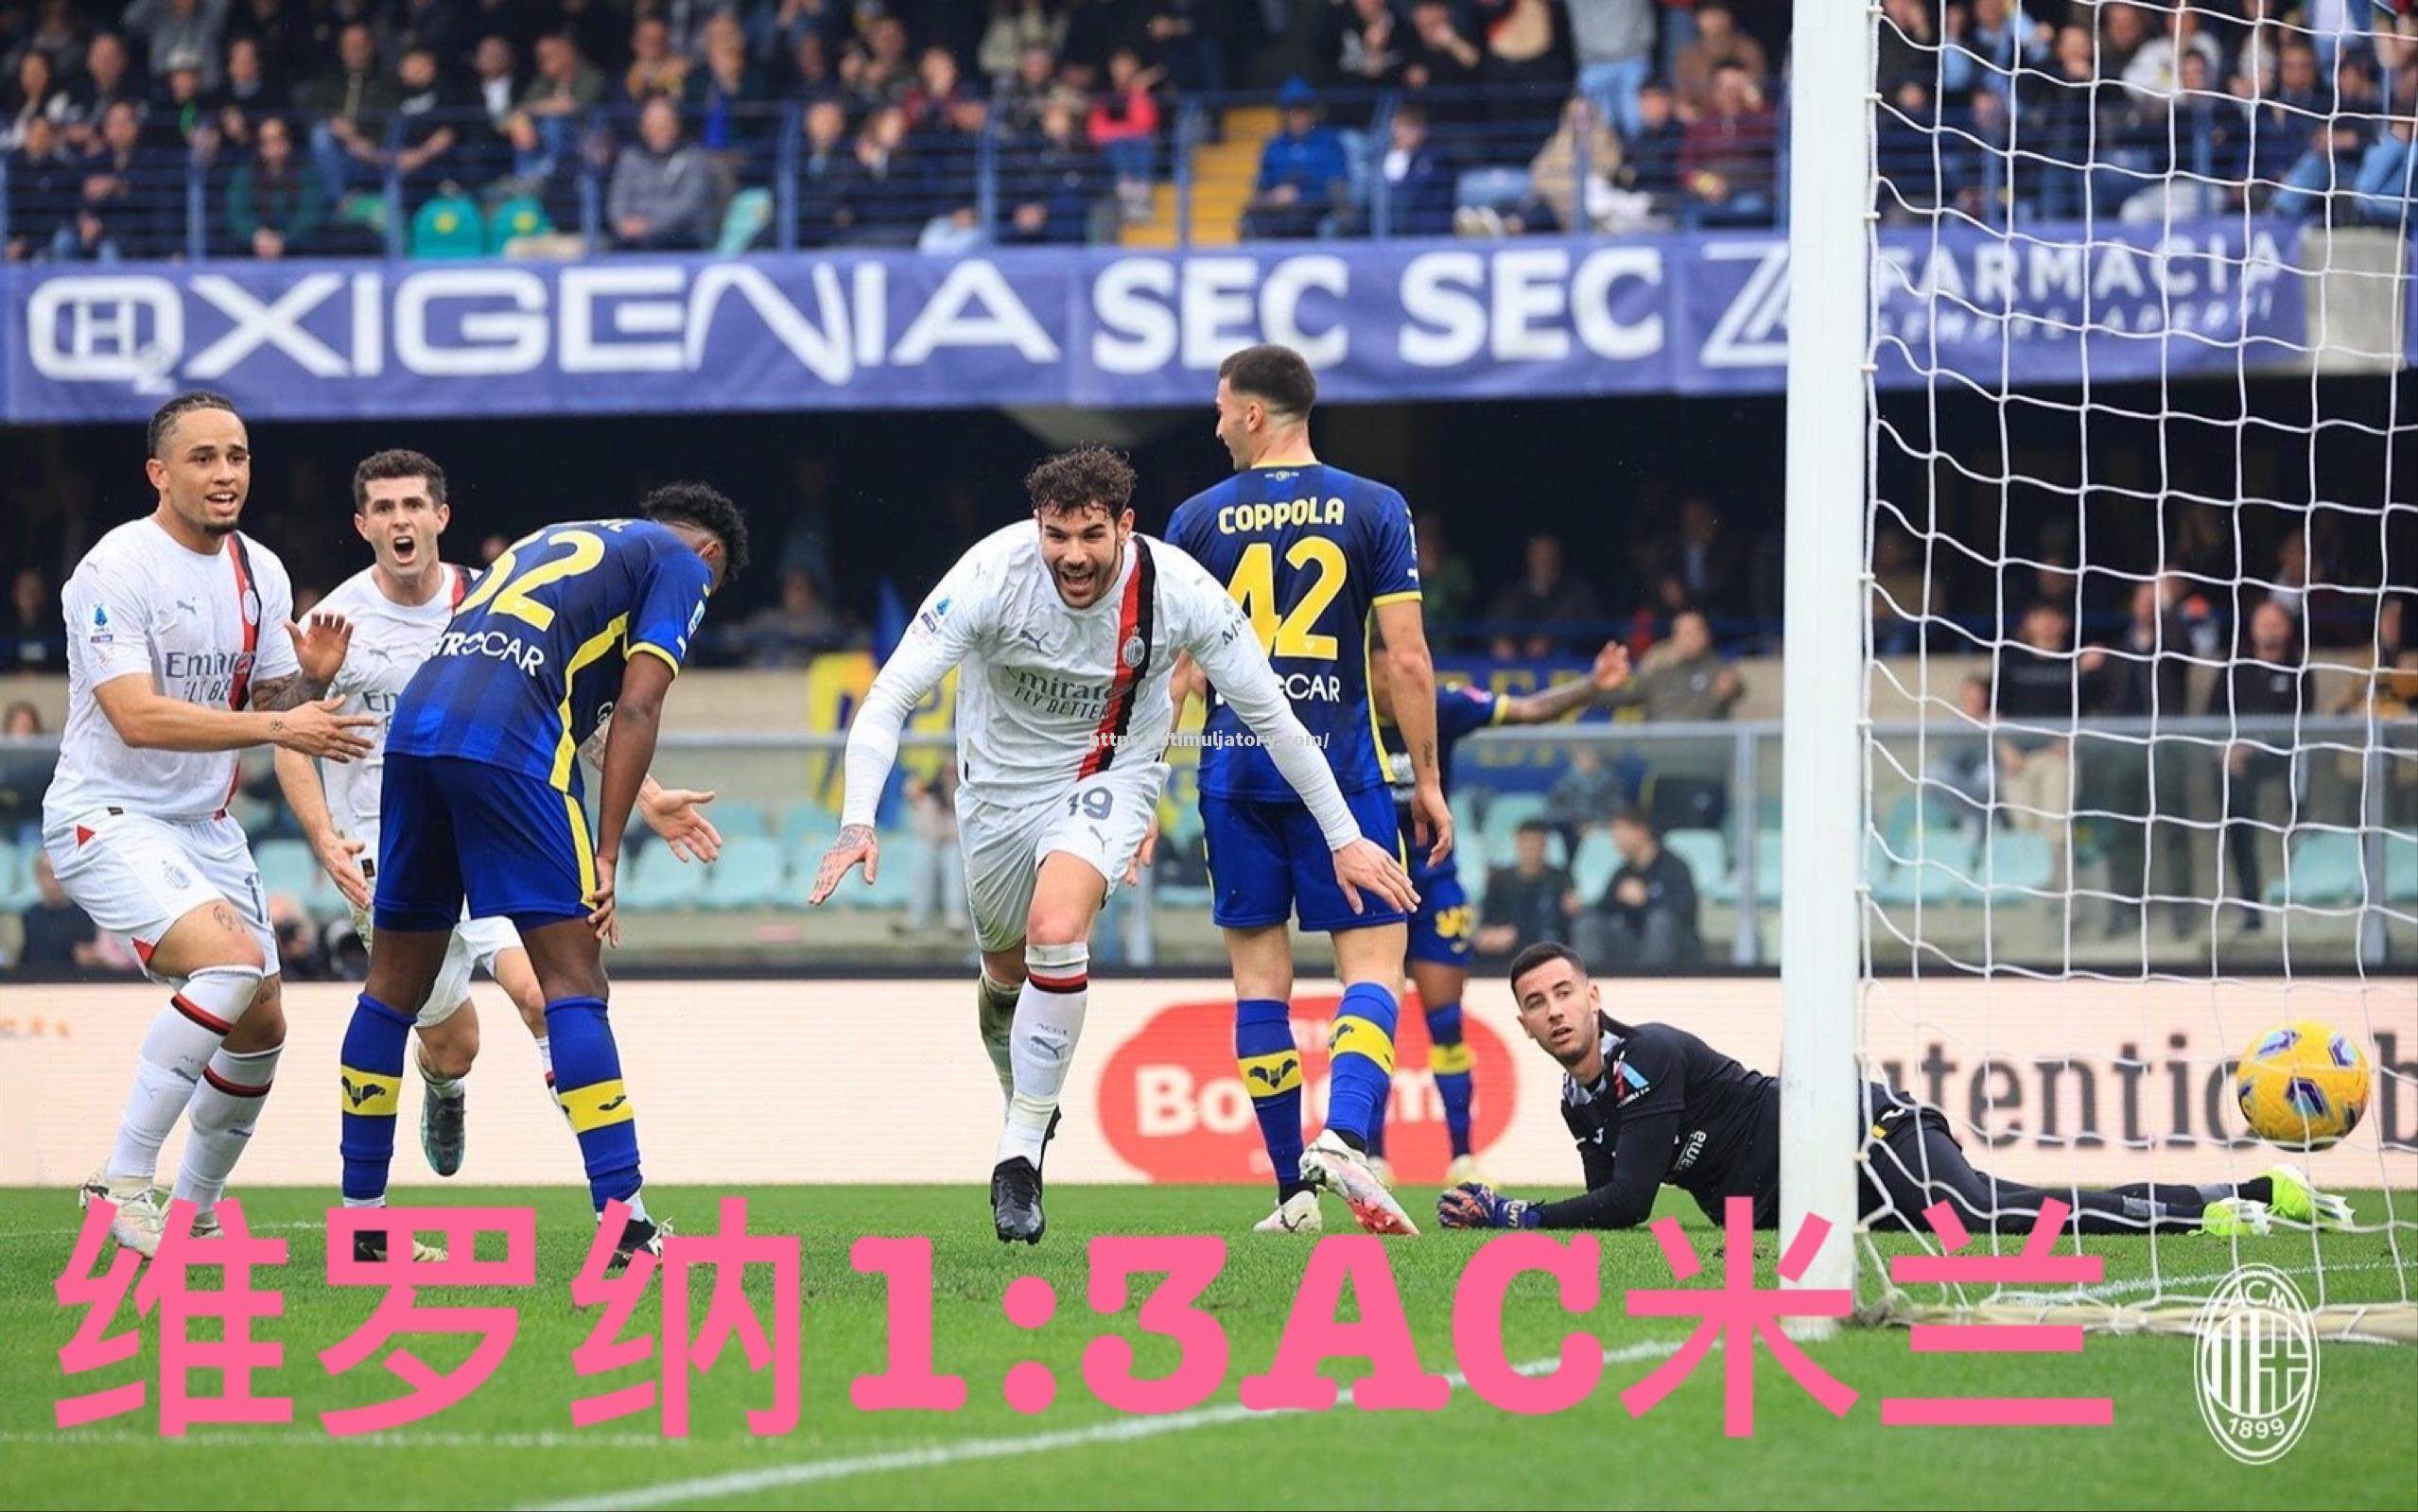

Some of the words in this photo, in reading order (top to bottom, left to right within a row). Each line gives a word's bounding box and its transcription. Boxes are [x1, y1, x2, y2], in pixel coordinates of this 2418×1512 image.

[1092, 255, 1349, 374] SEC
[1398, 247, 1664, 367] SEC
[1218, 496, 1346, 535] COPPOLA
[1226, 535, 1348, 661] 42
[1004, 665, 1136, 702] mirate
